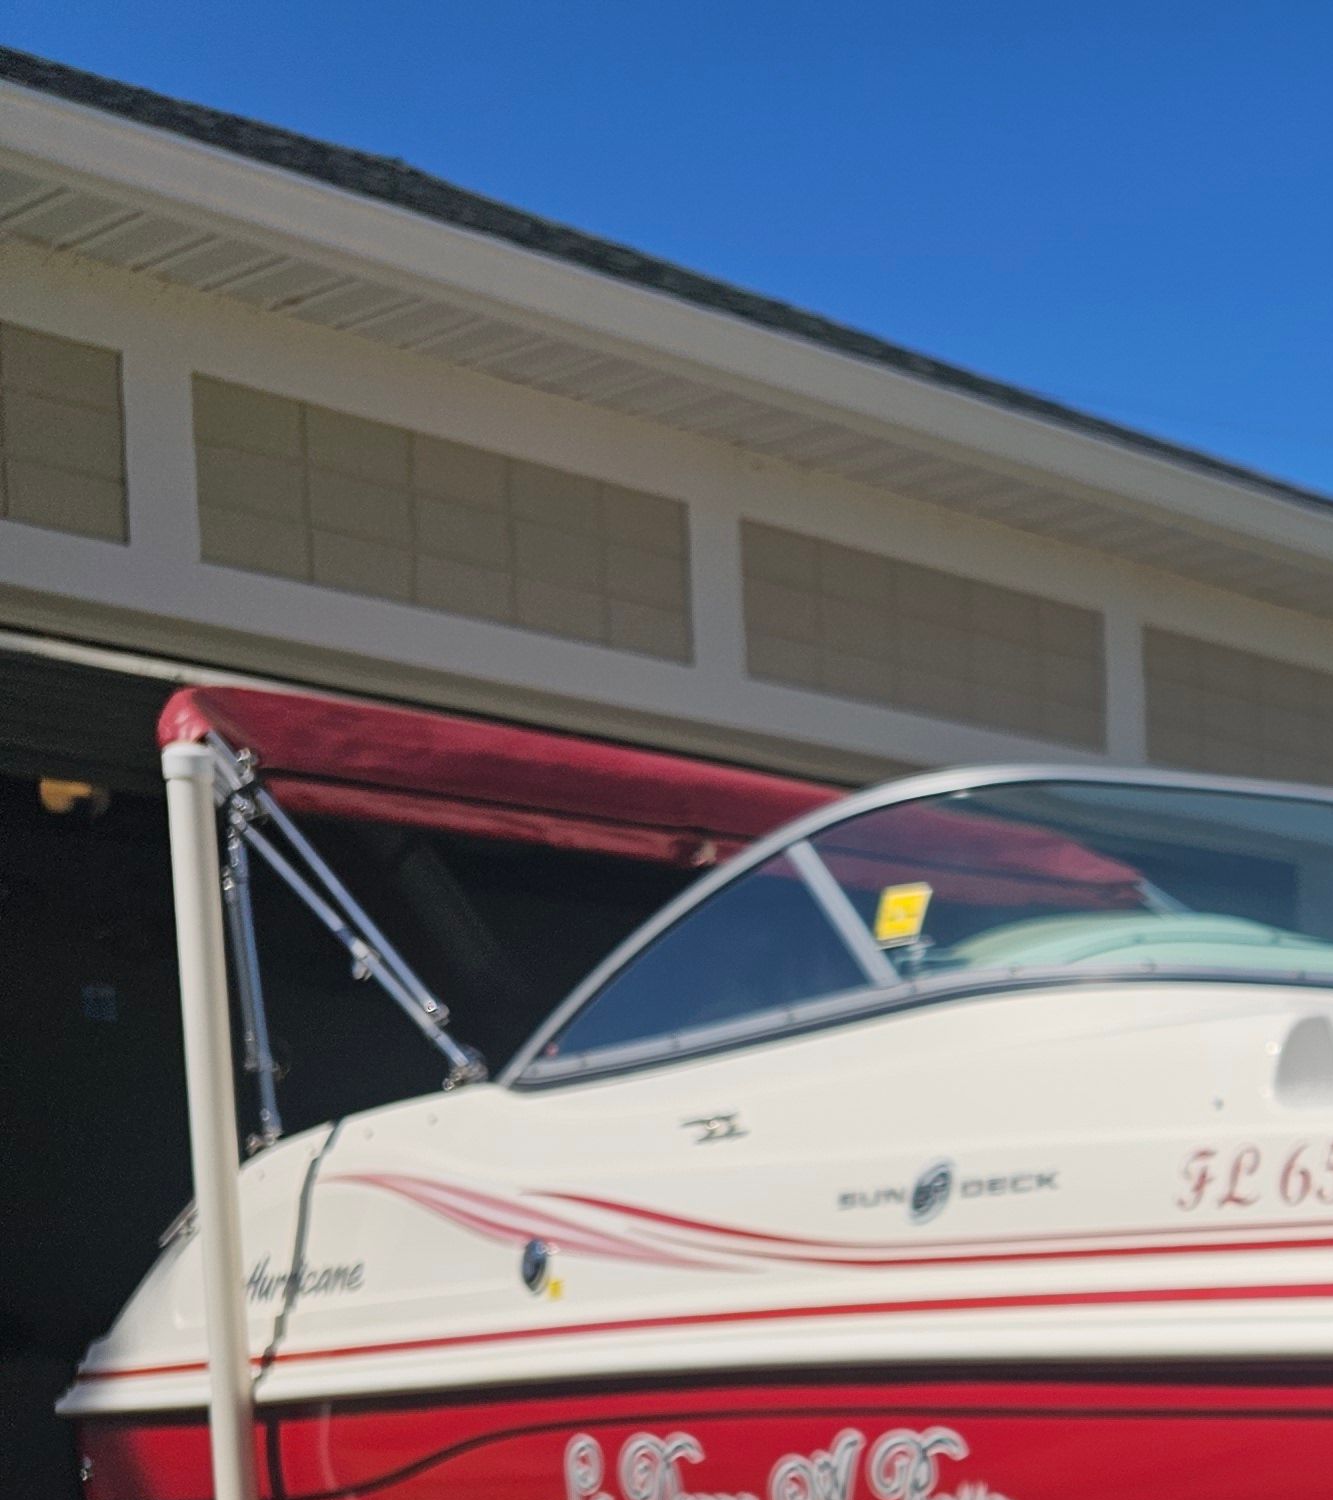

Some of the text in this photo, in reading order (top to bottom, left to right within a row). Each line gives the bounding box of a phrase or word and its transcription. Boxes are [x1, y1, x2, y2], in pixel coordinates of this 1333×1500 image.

[837, 1169, 1060, 1211] SUN DECK
[1176, 1144, 1262, 1212] FL
[246, 1253, 365, 1303] Hurricane
